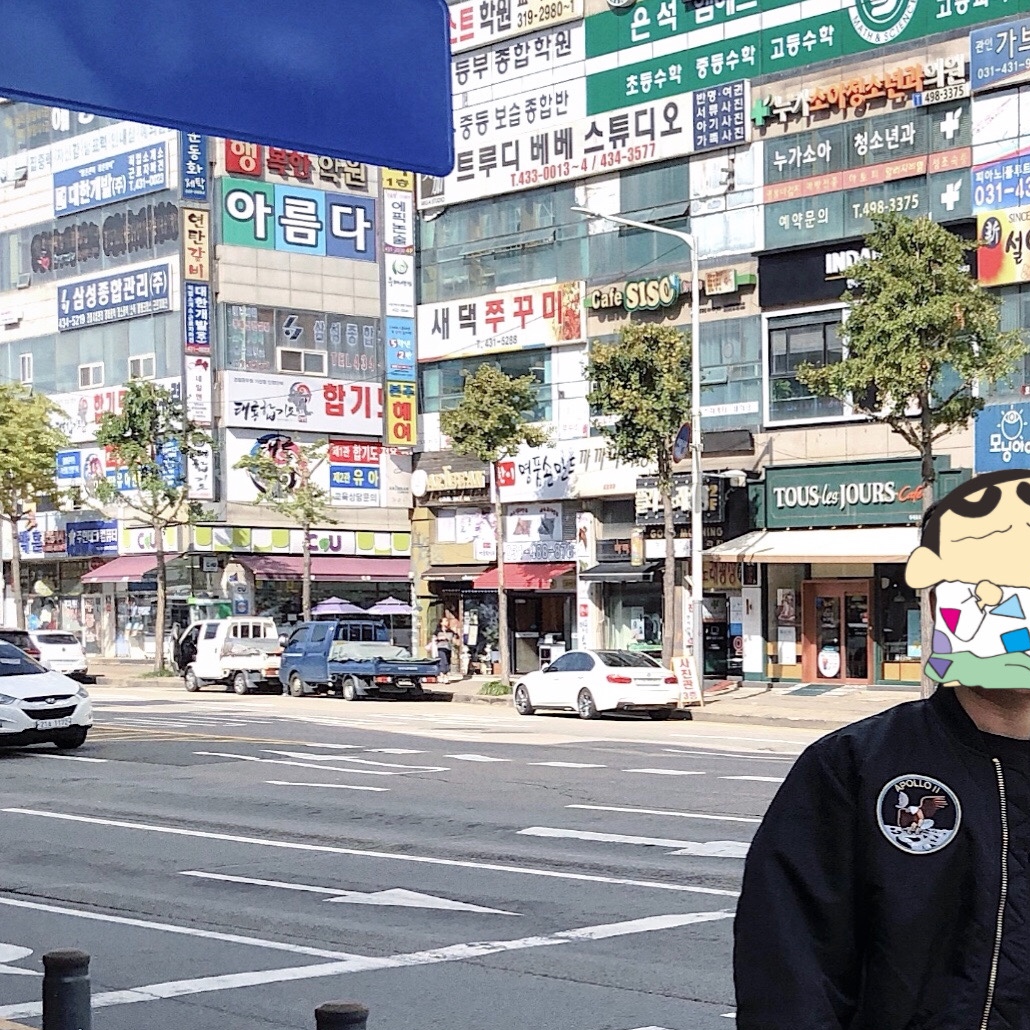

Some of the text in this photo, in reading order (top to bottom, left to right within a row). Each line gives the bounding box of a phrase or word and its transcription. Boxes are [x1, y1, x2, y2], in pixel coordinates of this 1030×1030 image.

[480, 0, 511, 34] 학원
[626, 24, 835, 96] 초등수학 중등수학 고등수학
[925, 85, 964, 102] 498-3375
[457, 101, 682, 182] 트루디 베베 스튜디오
[600, 142, 657, 168] 434-3577
[773, 123, 915, 171] 누가소아 청소년과
[226, 189, 372, 251] 아름다
[778, 194, 919, 230] 예약문의 T.498-3375
[73, 270, 167, 311] 삼성종합관리(주)
[591, 287, 623, 310] Cafe
[625, 276, 674, 309] SISO
[353, 444, 379, 461] 합기도
[773, 485, 819, 508] TOUS
[821, 486, 840, 505] les
[840, 481, 896, 510] JOURS
[308, 532, 342, 553] CU
[894, 779, 932, 792] APOLLO
